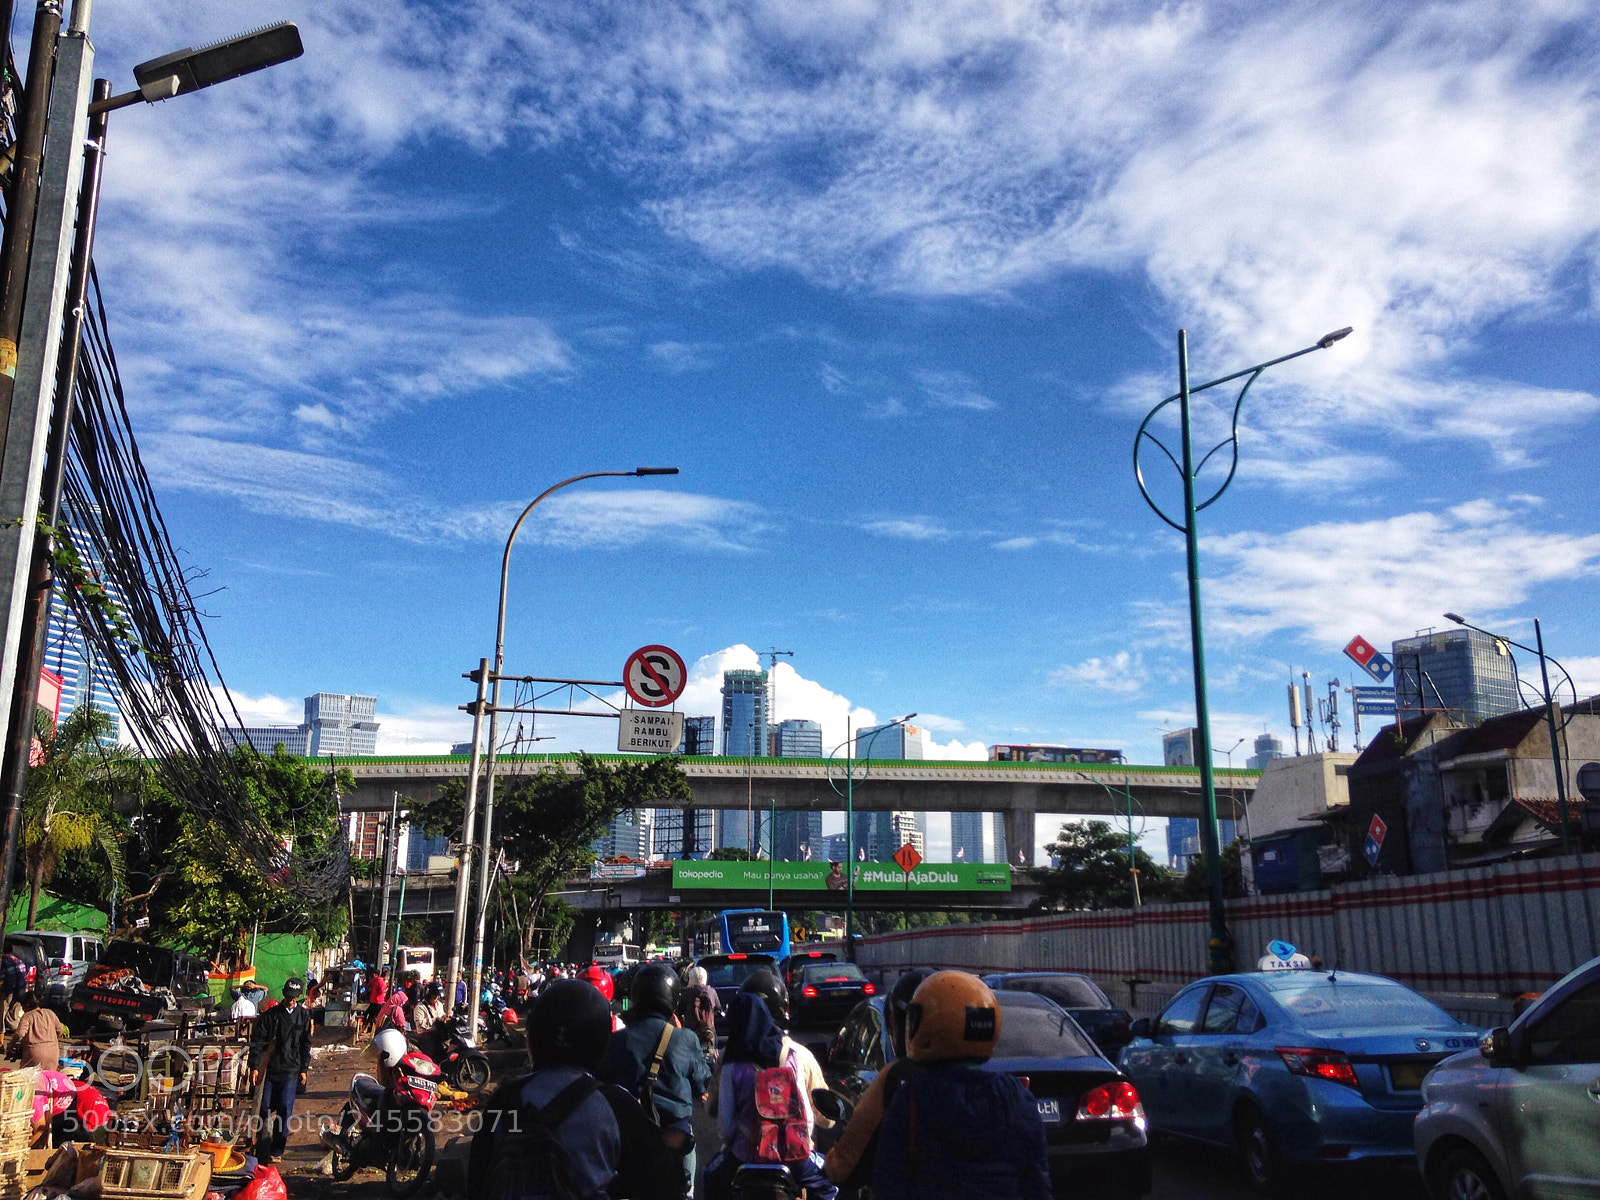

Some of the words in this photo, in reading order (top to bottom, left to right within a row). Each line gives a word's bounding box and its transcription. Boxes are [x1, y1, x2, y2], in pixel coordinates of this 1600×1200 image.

[634, 715, 670, 725] SAMPAI
[634, 727, 668, 737] RAMBU
[630, 738, 670, 748] BERIKUT
[678, 870, 724, 881] tokopedia
[743, 871, 762, 879] Mau
[793, 871, 824, 879] usaha?
[863, 870, 959, 885] #MulaiAjaDulu
[93, 994, 141, 1008] MITSUBISHI
